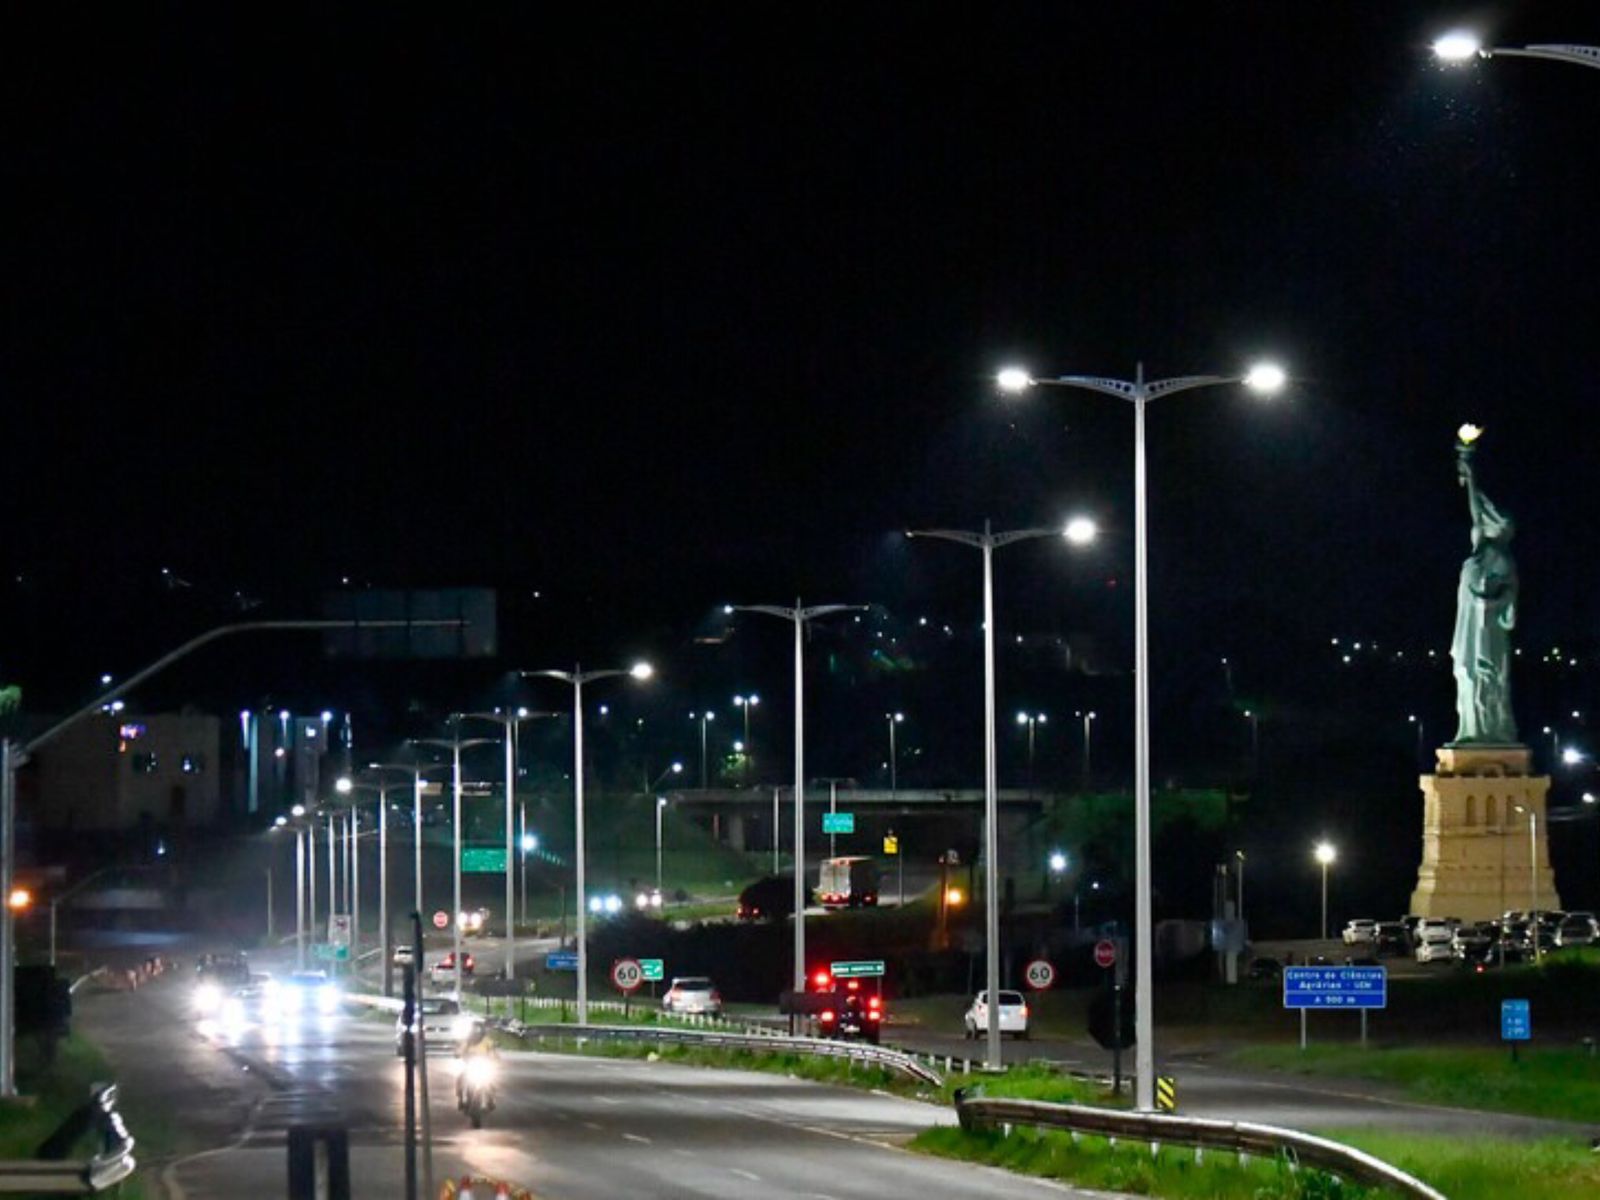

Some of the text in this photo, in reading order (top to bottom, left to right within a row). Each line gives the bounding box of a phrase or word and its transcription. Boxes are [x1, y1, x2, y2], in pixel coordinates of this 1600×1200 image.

[617, 966, 638, 980] 60
[1029, 967, 1050, 980] 60
[1324, 971, 1337, 980] de
